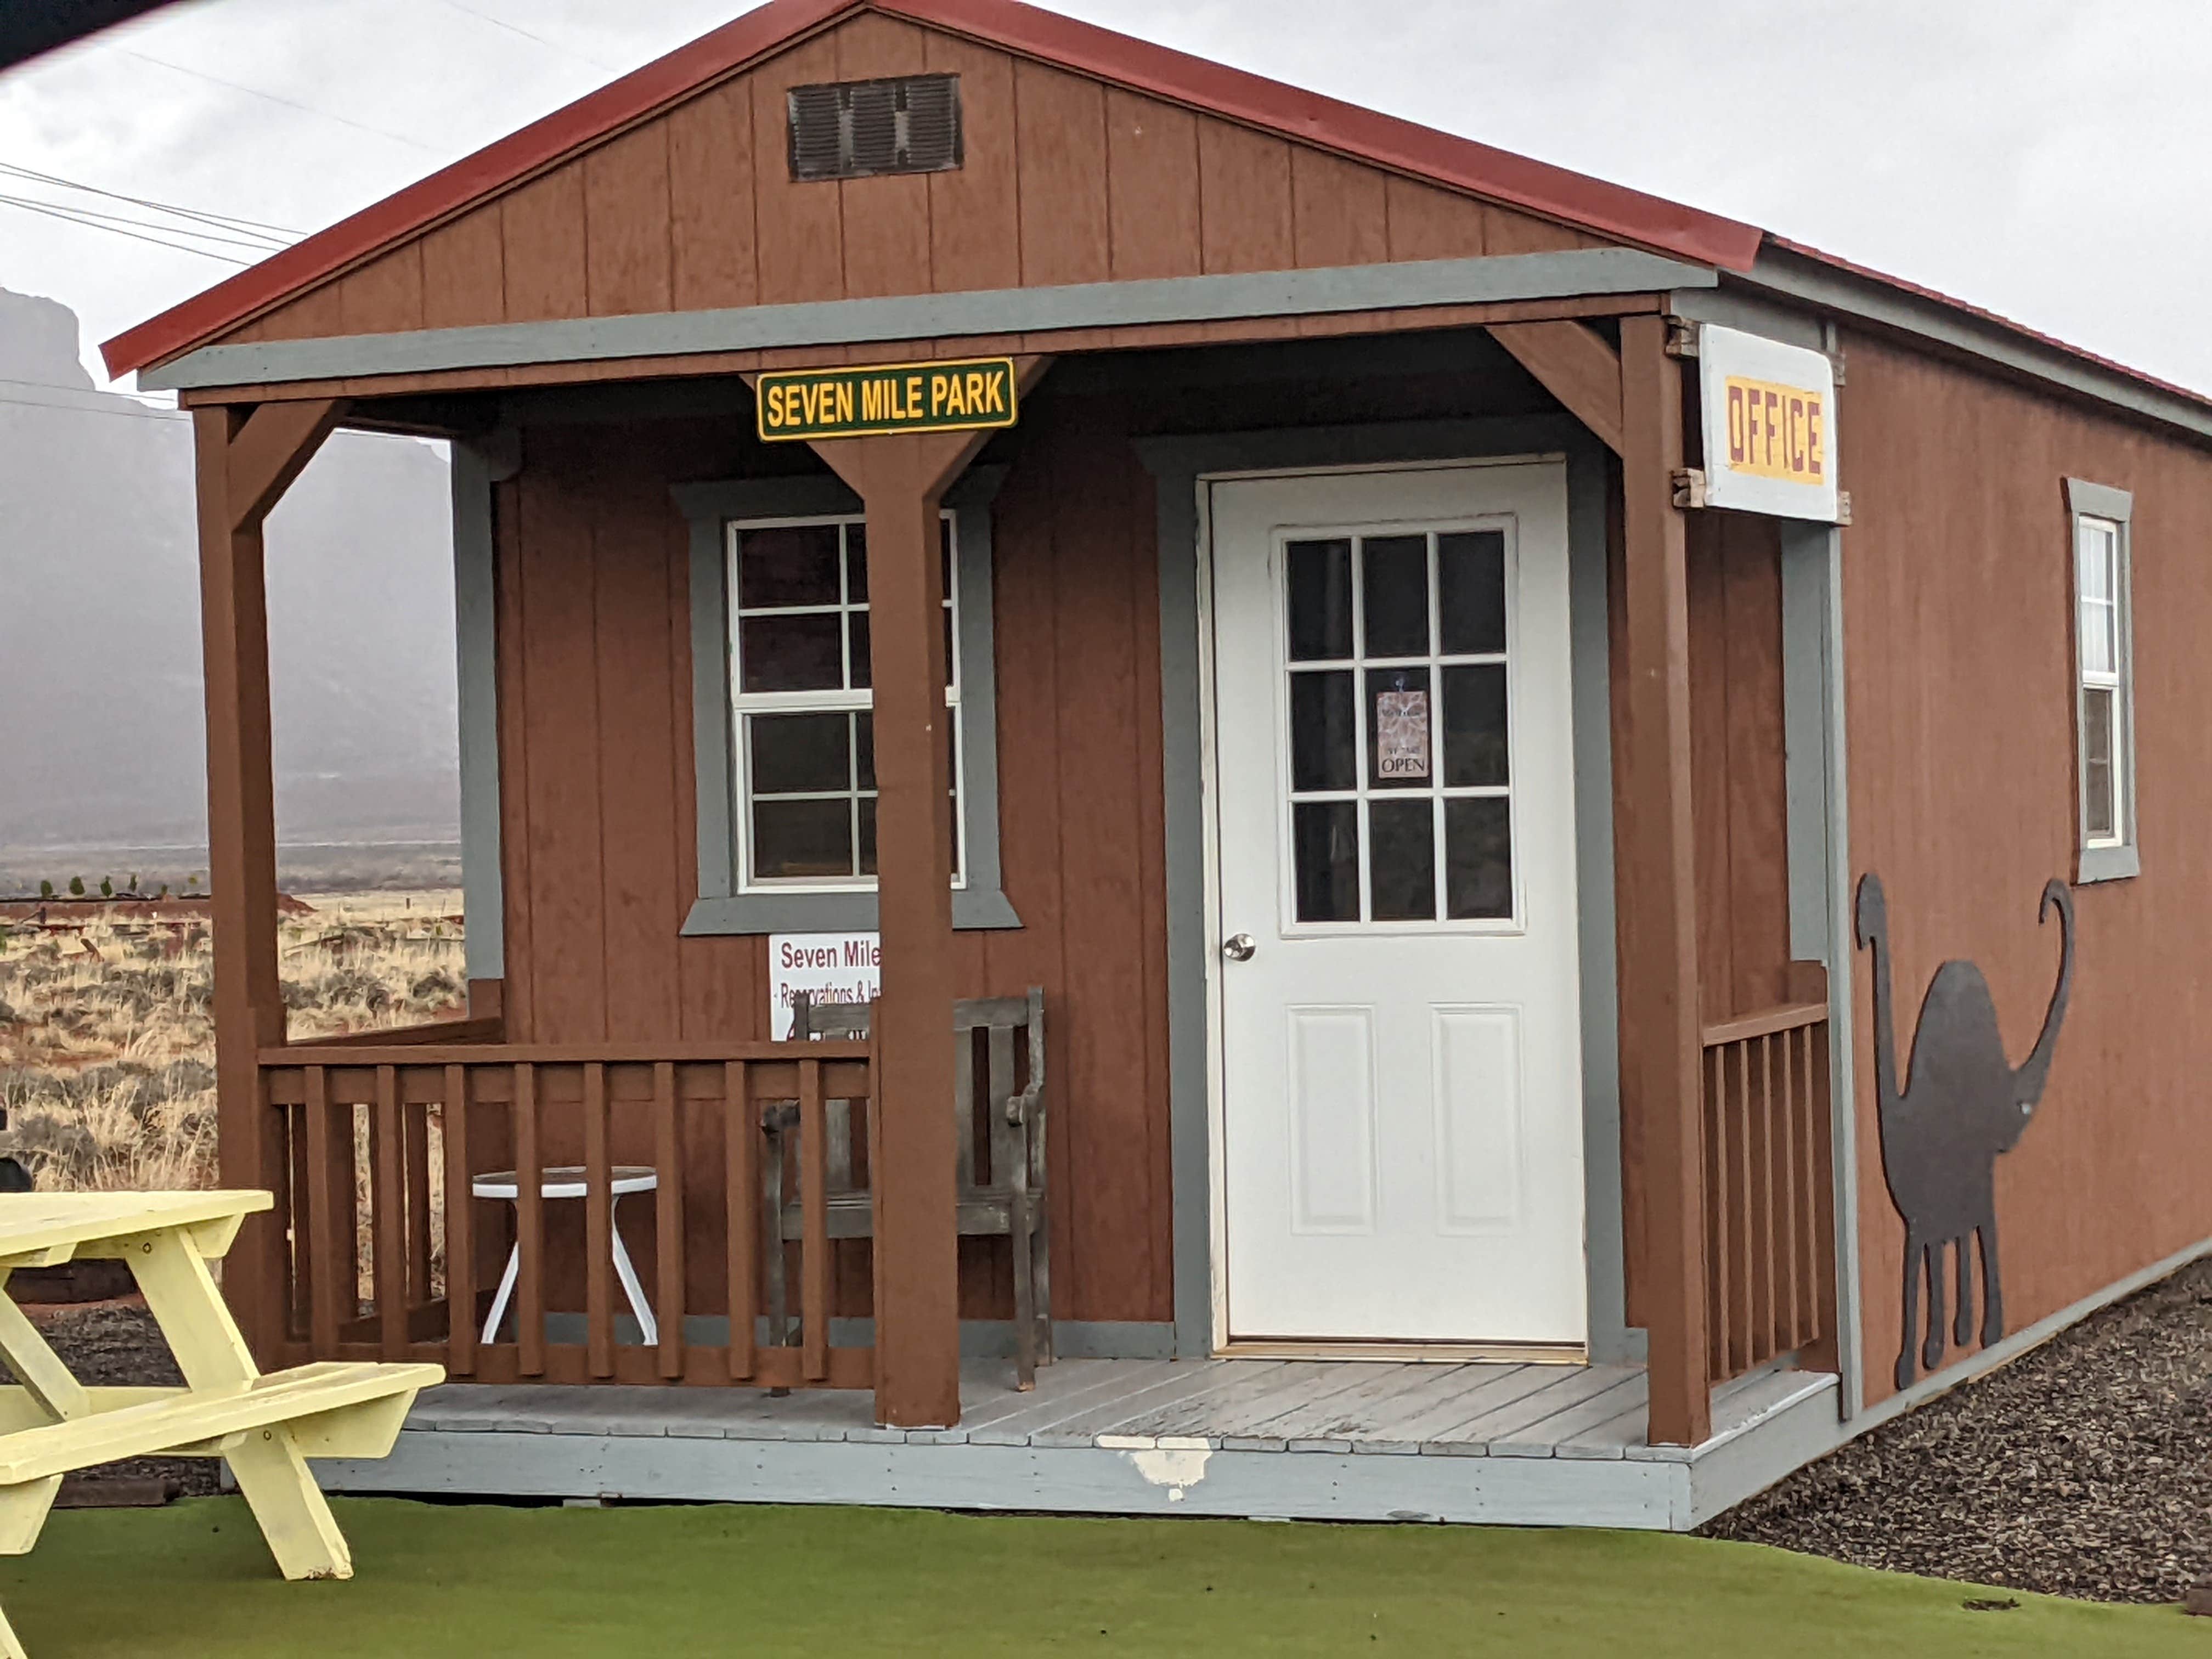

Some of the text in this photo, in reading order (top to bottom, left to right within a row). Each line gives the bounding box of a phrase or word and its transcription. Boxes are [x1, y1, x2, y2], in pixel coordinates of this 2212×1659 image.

[768, 370, 1005, 427] SEVEN MILE PARK
[1728, 385, 1821, 475] OFFICE
[1382, 758, 1425, 772] OPEN
[781, 940, 880, 968] Seven Mile
[780, 981, 853, 1008] Rervations
